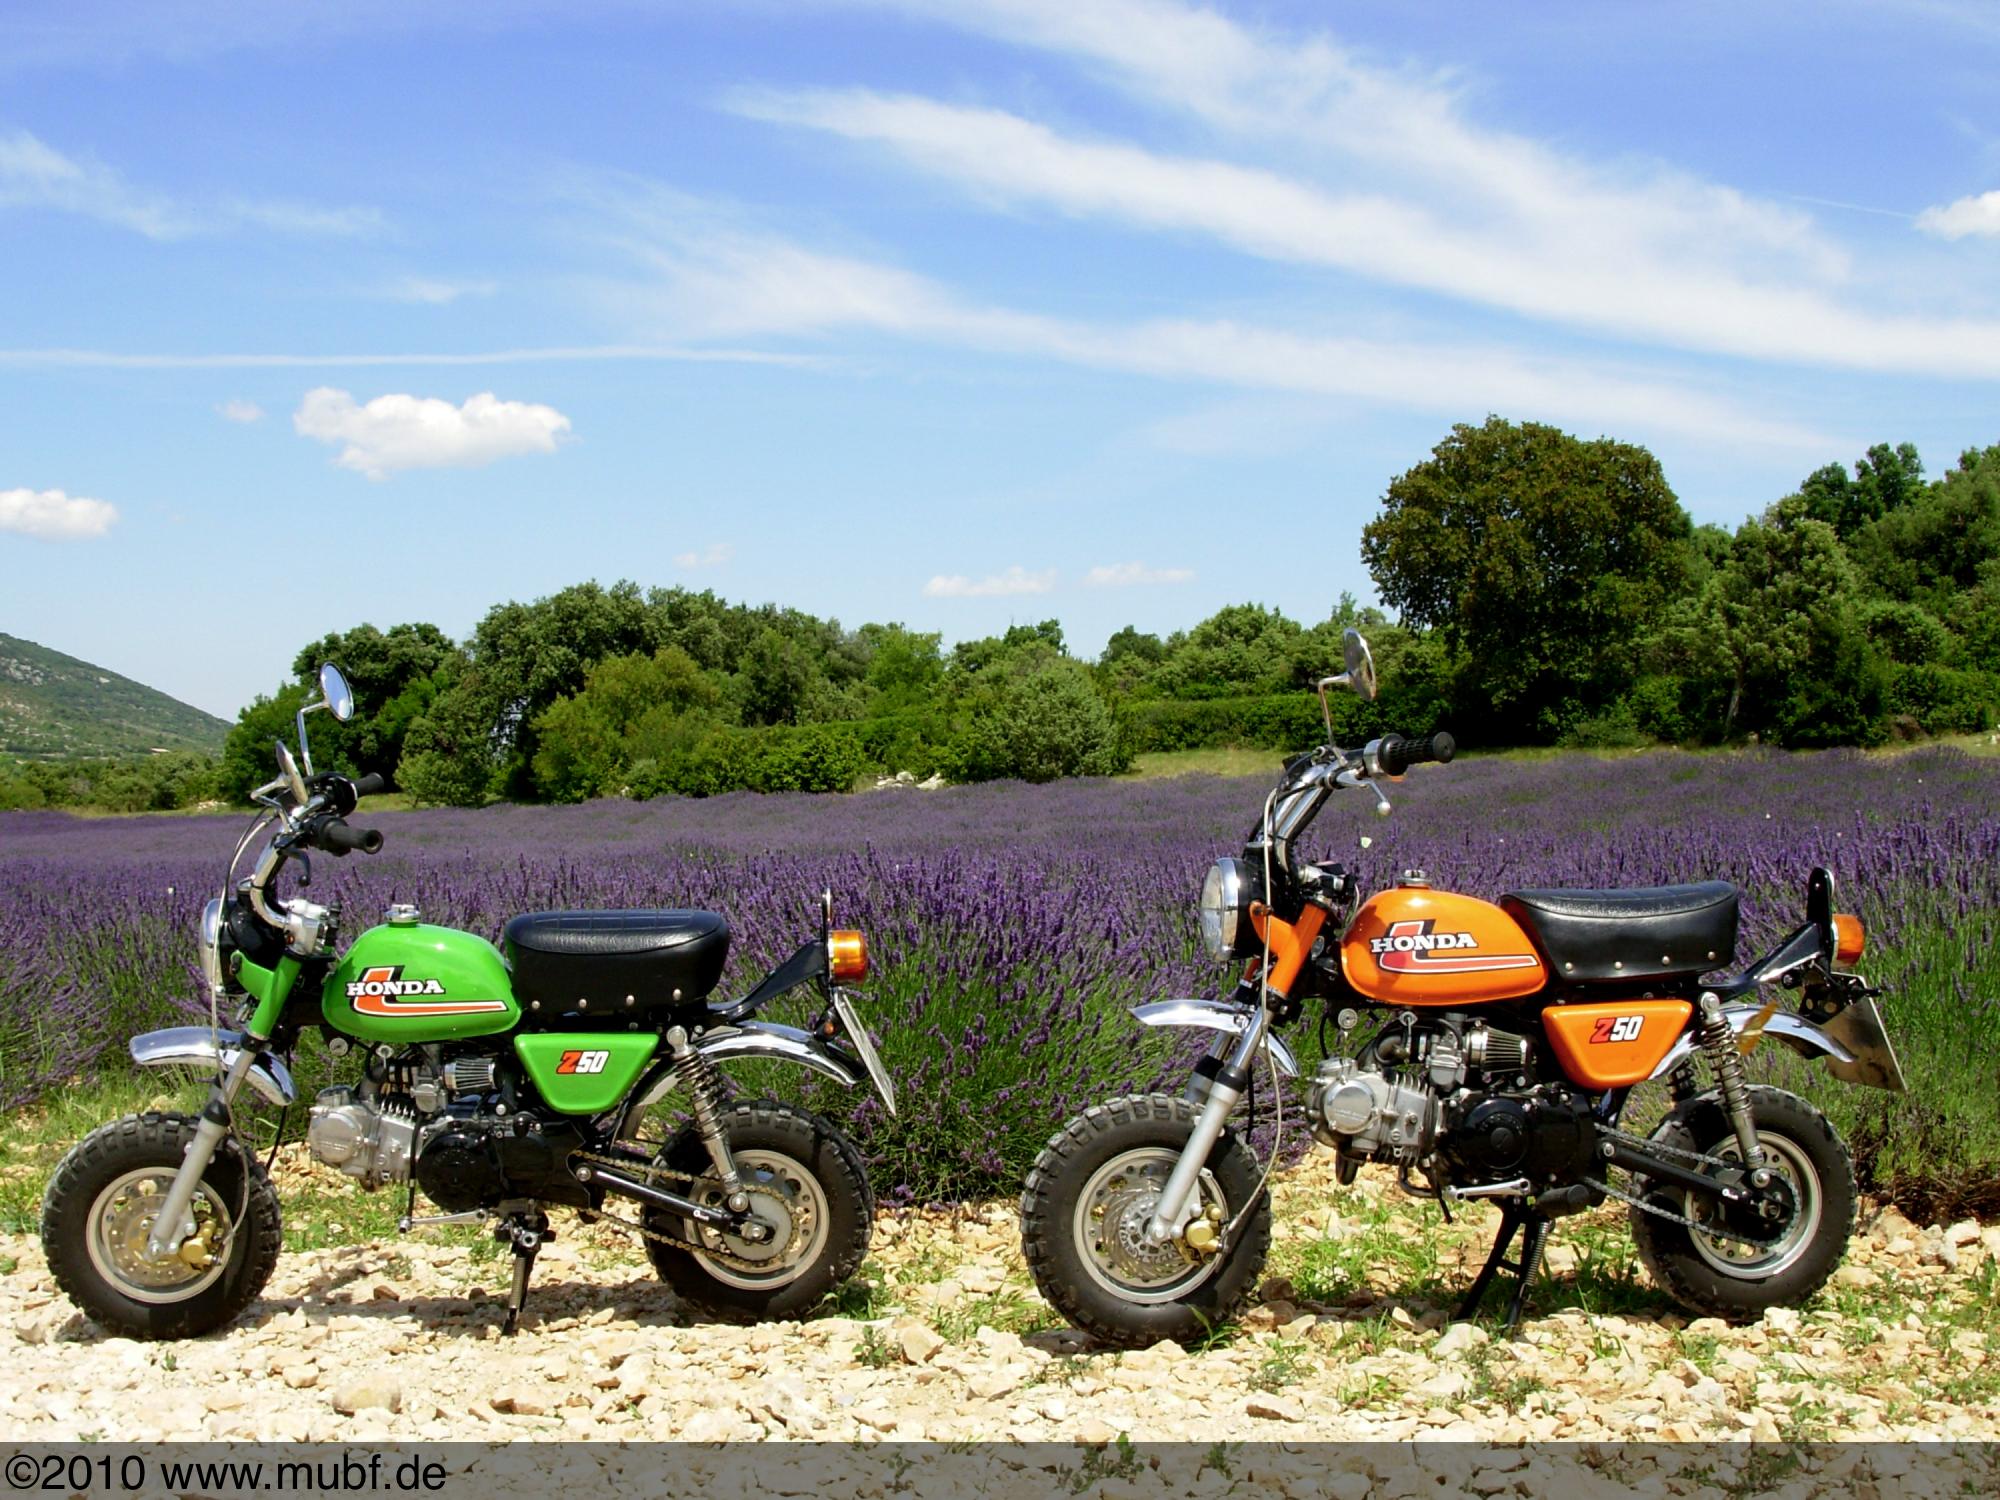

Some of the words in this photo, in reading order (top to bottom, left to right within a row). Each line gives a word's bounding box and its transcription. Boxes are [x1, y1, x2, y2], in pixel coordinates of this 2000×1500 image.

[1371, 933, 1478, 953] HONDA
[346, 979, 445, 997] HONDA
[1589, 1015, 1645, 1044] Z50
[556, 1050, 610, 1074] Z50
